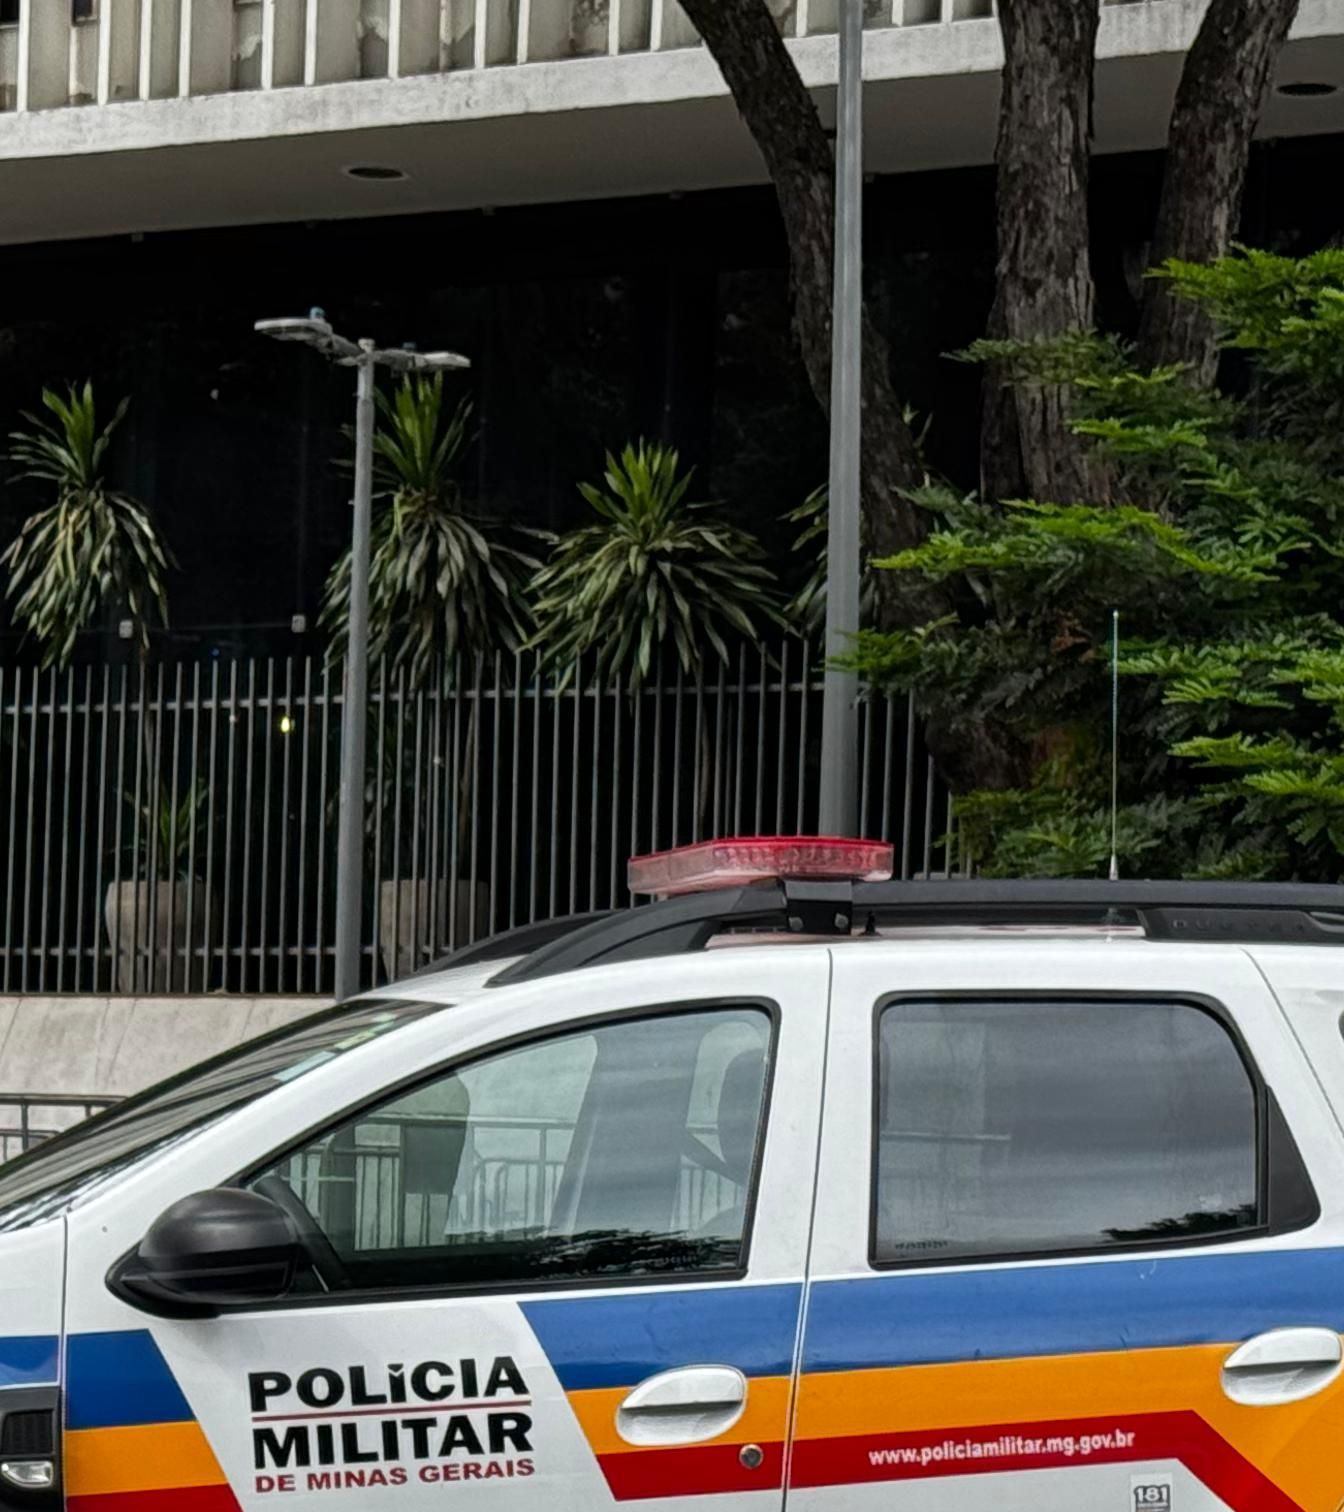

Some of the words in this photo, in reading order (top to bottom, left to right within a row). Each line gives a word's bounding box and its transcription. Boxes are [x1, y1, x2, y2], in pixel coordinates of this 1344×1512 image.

[252, 1412, 534, 1470] MILITAR
[867, 1428, 1136, 1466] www.policiamilitar.mg.gov.br
[256, 1474, 296, 1493] DE
[307, 1467, 408, 1491] MINAS
[418, 1458, 536, 1484] GERAIS
[1136, 1486, 1168, 1503] 181
